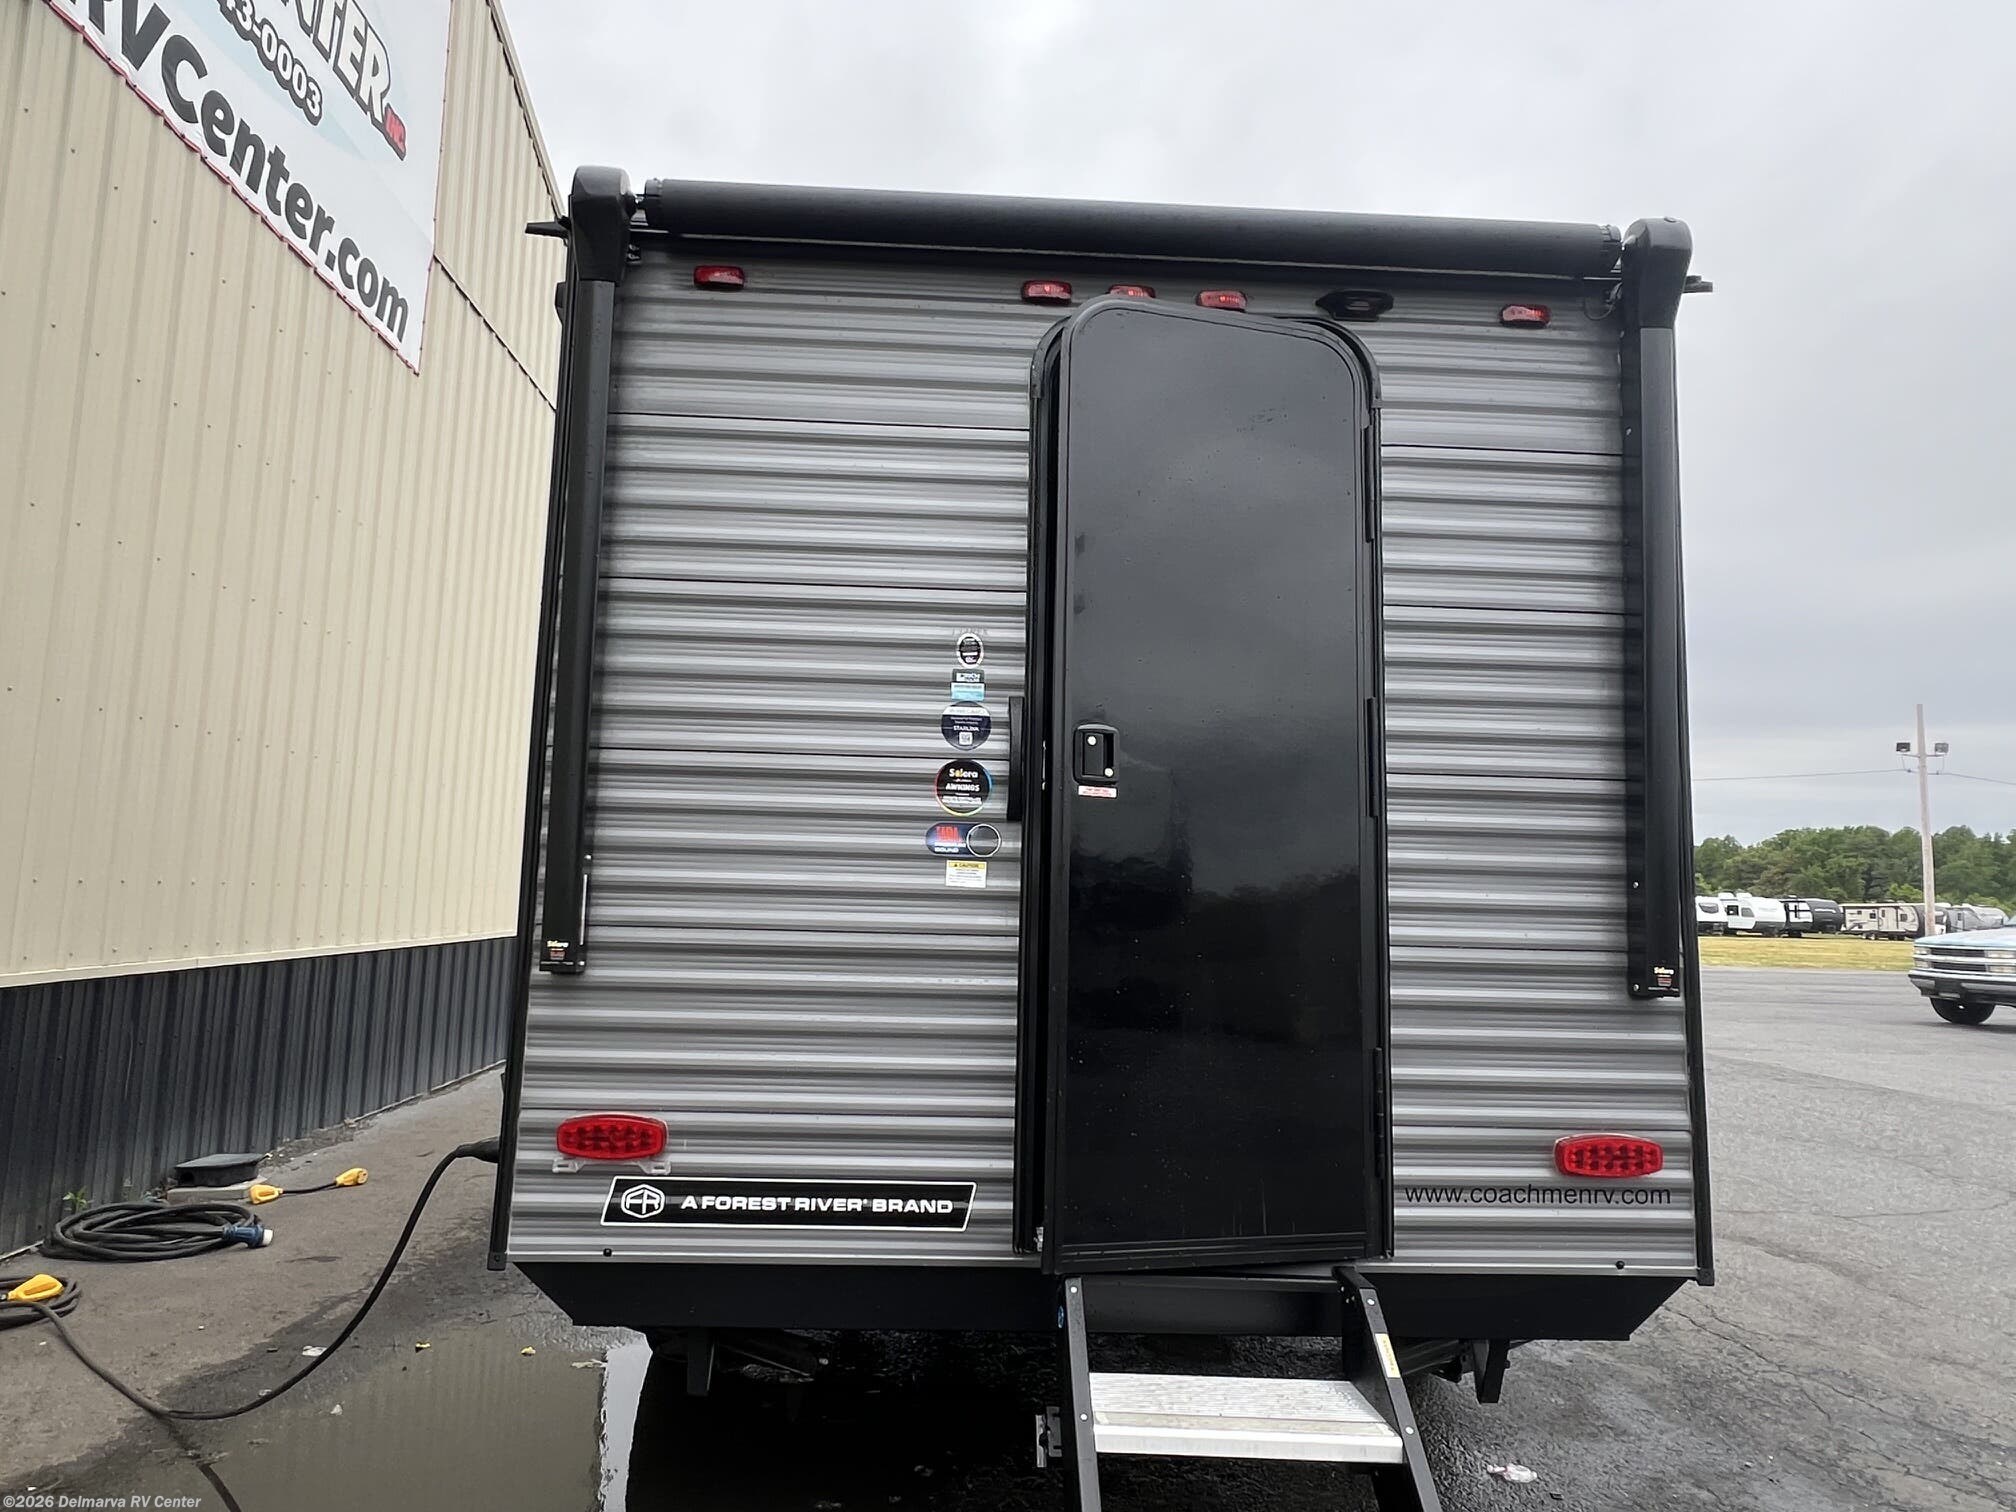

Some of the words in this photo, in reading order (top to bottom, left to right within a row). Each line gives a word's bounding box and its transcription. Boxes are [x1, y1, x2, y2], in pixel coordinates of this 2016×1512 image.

[680, 1195, 698, 1209] A
[701, 1196, 790, 1211] FOREST
[872, 1198, 953, 1213] BRAND
[1405, 1184, 1671, 1205] www.coachmenrv.com
